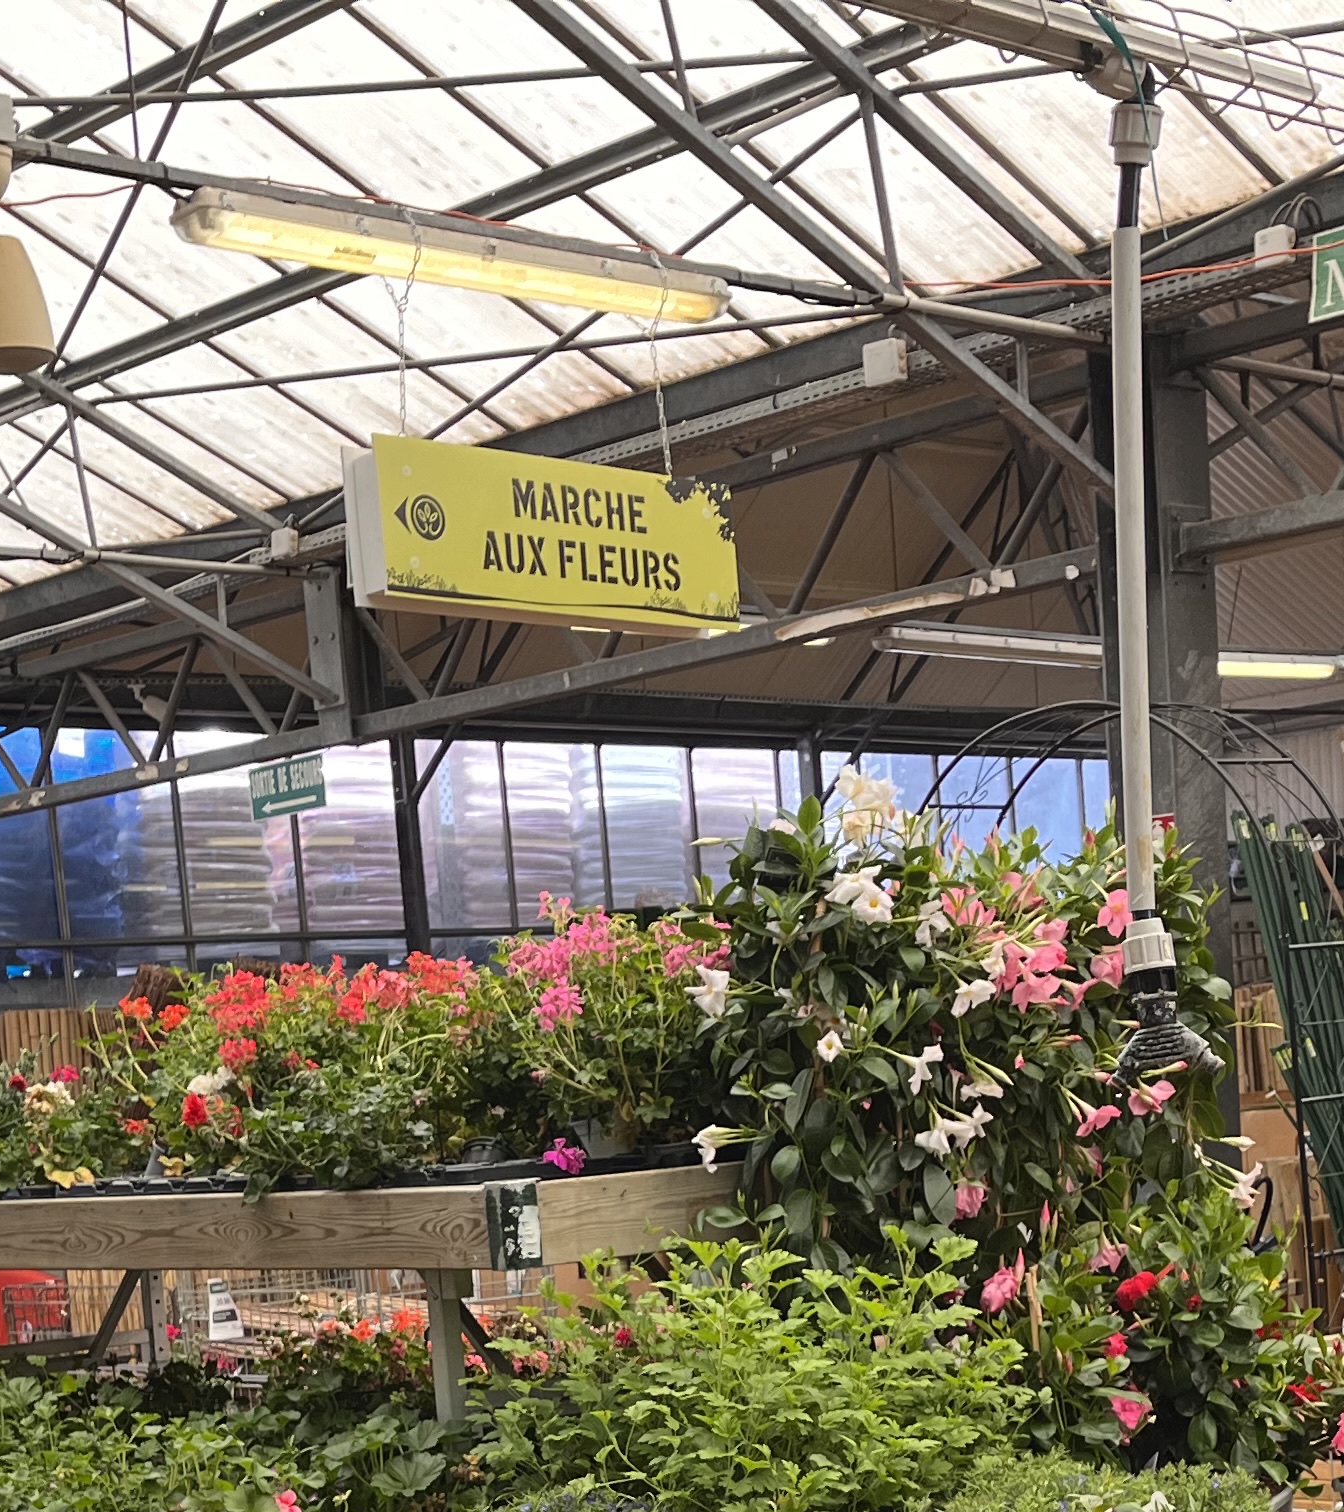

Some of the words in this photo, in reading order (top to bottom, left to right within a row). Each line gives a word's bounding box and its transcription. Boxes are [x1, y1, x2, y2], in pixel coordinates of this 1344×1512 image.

[511, 477, 649, 534] MARCHE
[482, 530, 548, 578] AUX
[557, 538, 682, 592] FLEURS
[277, 765, 289, 793] DE
